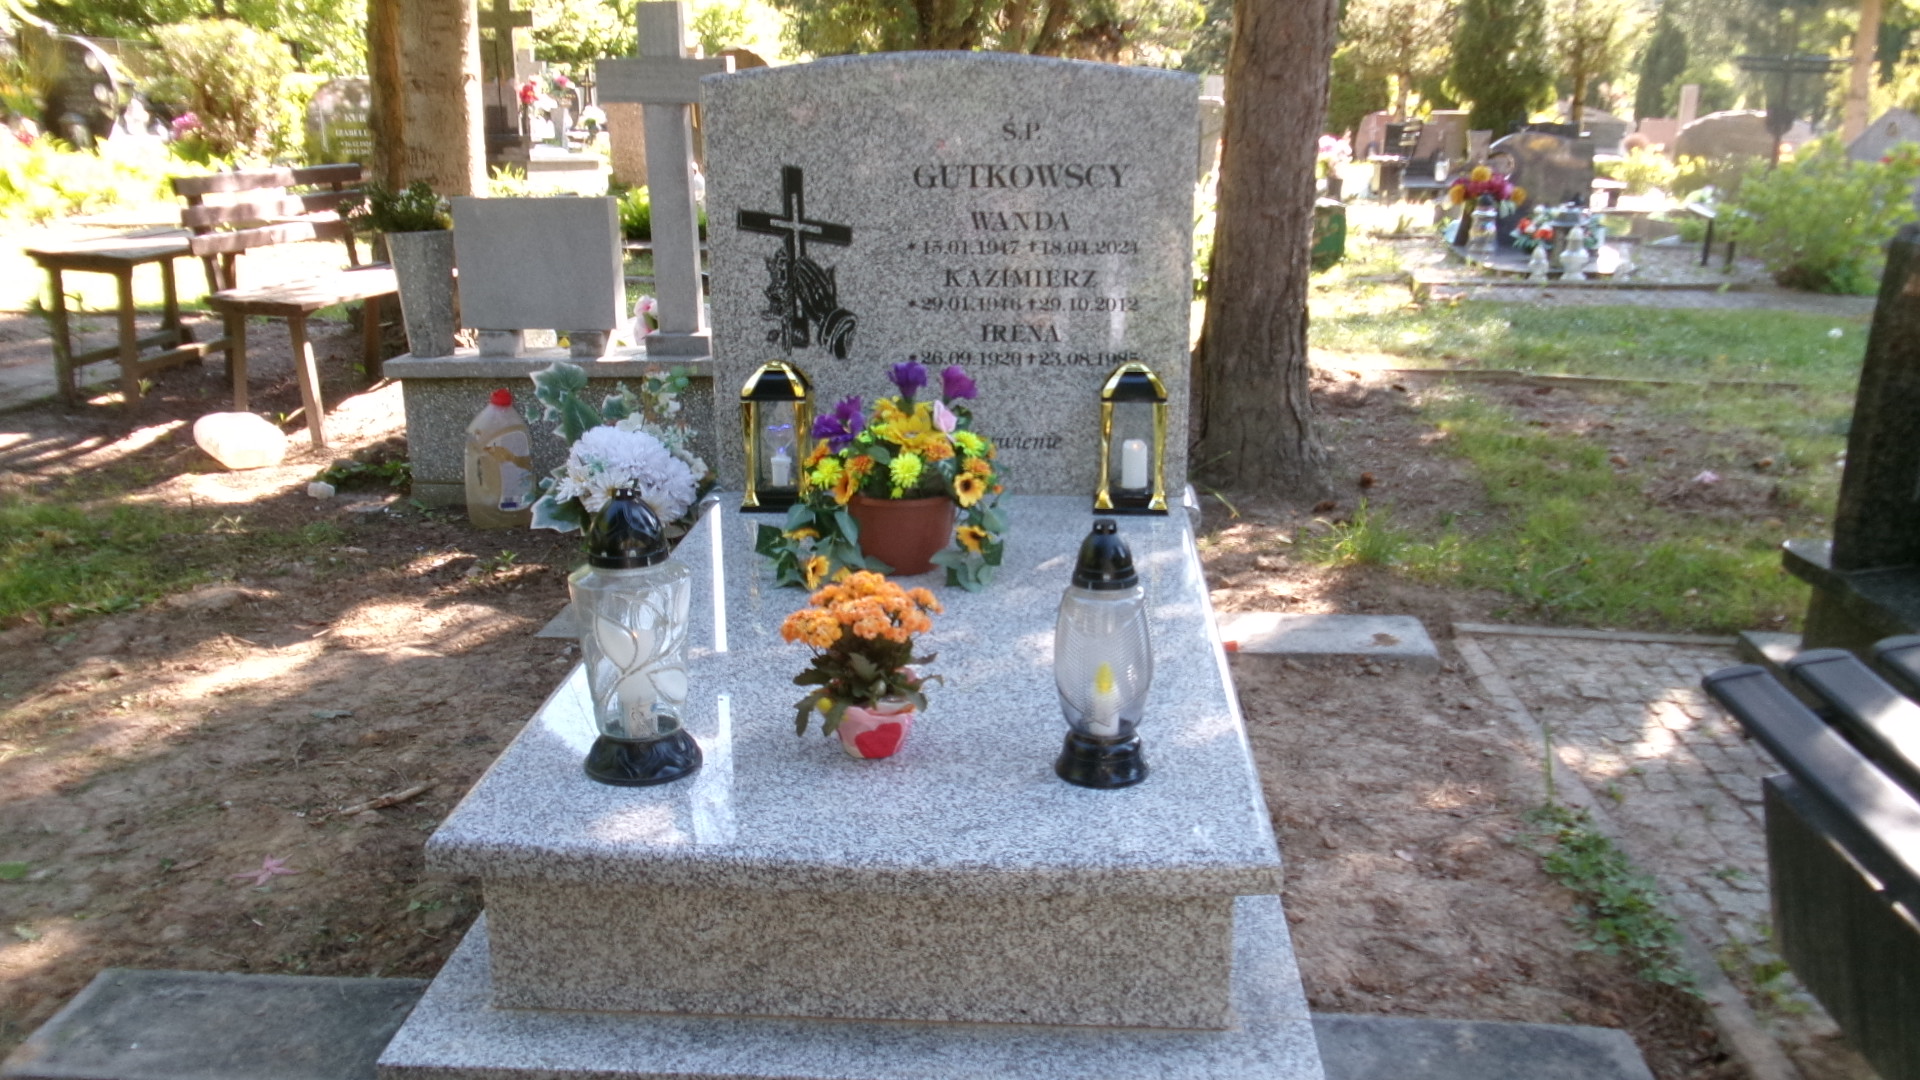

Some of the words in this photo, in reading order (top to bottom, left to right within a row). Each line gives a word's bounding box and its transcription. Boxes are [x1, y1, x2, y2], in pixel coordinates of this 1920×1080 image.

[913, 163, 1132, 189] GUTKOWSCY
[971, 211, 1070, 231] WANDA
[943, 269, 1097, 287] KAZIMIERZ
[981, 324, 1061, 342] IRENA
